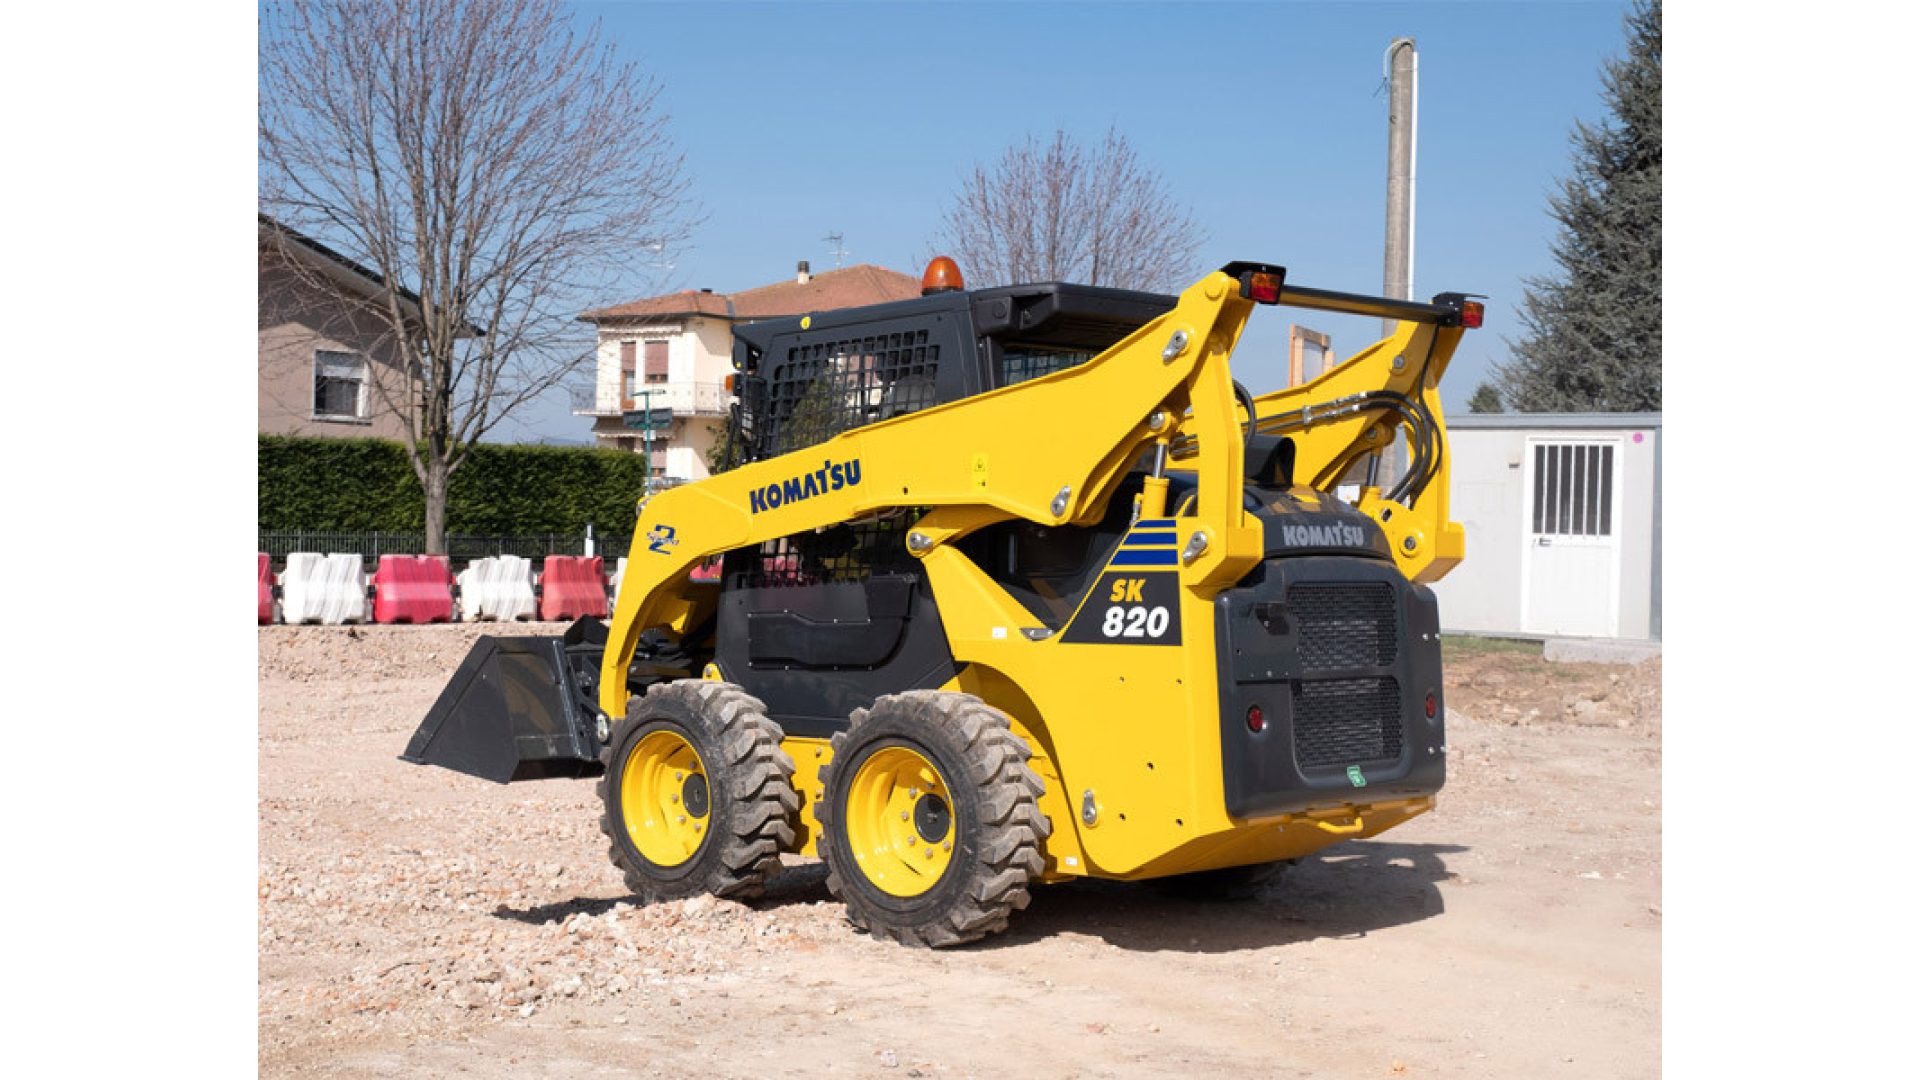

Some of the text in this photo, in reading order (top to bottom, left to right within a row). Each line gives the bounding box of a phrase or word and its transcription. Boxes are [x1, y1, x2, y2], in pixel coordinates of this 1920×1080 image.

[749, 459, 861, 513] KOMATSU
[1283, 520, 1364, 546] KOMATSU
[1109, 579, 1146, 602] SK
[1102, 606, 1170, 638] 820
